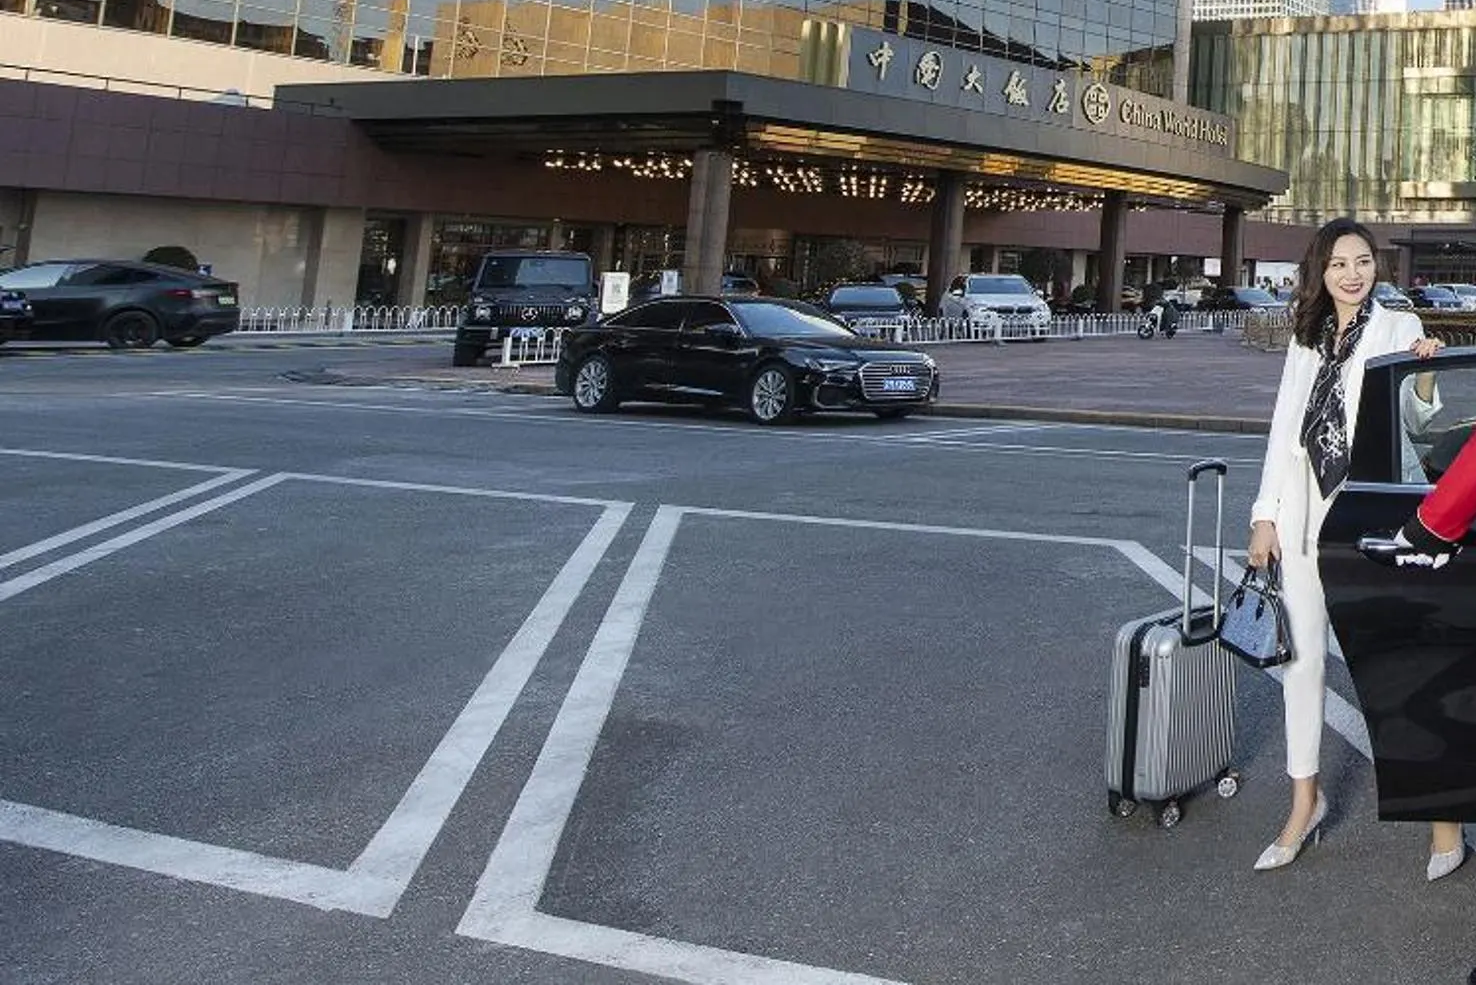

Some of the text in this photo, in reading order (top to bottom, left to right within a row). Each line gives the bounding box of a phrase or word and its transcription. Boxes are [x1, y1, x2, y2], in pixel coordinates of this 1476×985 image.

[1120, 98, 1228, 146] China World Hotel
